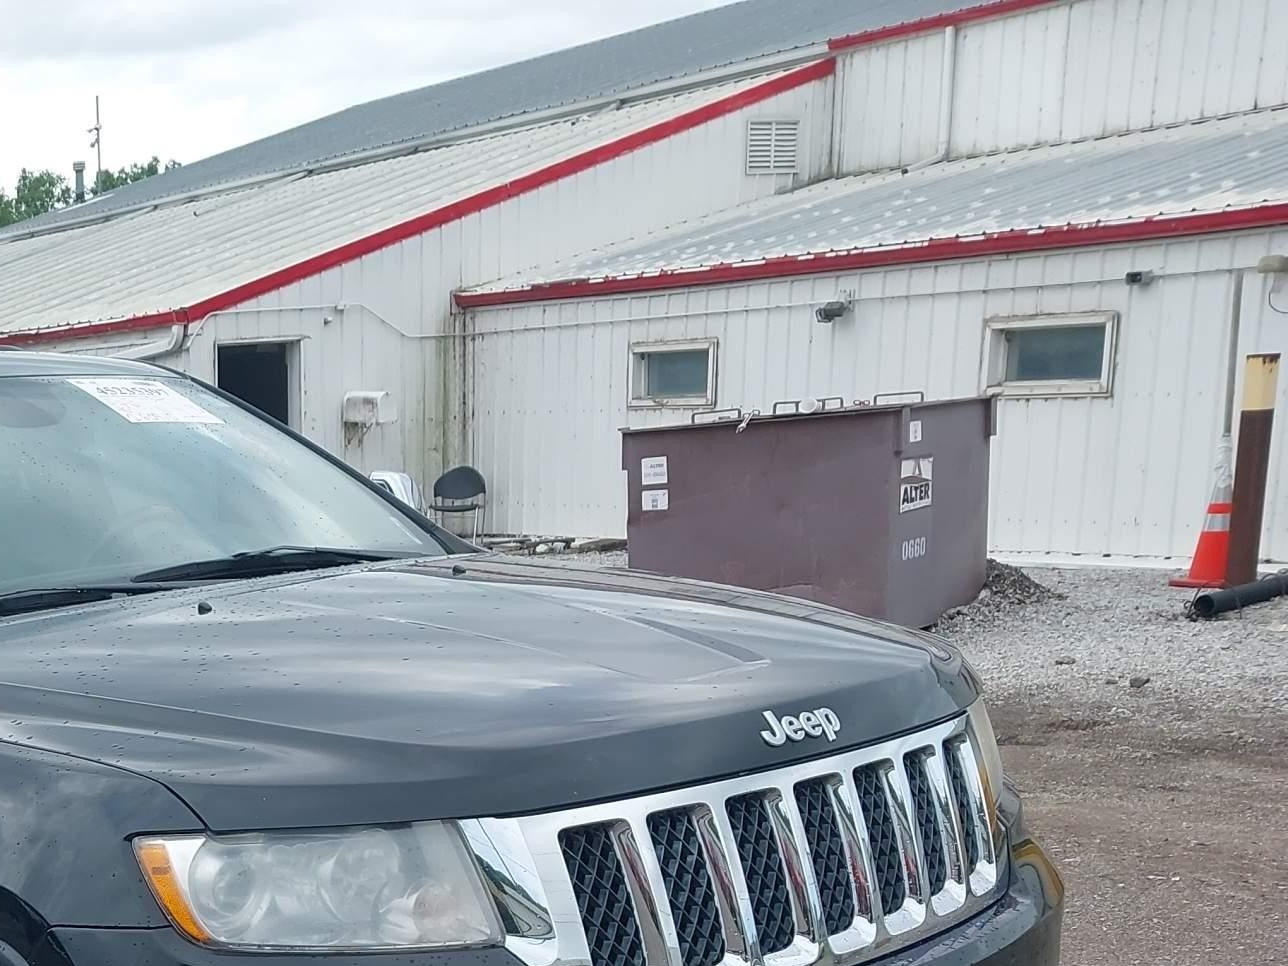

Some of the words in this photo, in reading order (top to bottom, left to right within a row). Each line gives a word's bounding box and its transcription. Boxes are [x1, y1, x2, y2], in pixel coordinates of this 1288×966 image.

[901, 482, 931, 506] ALTER
[902, 536, 926, 561] 0660
[760, 707, 841, 746] Jeep
